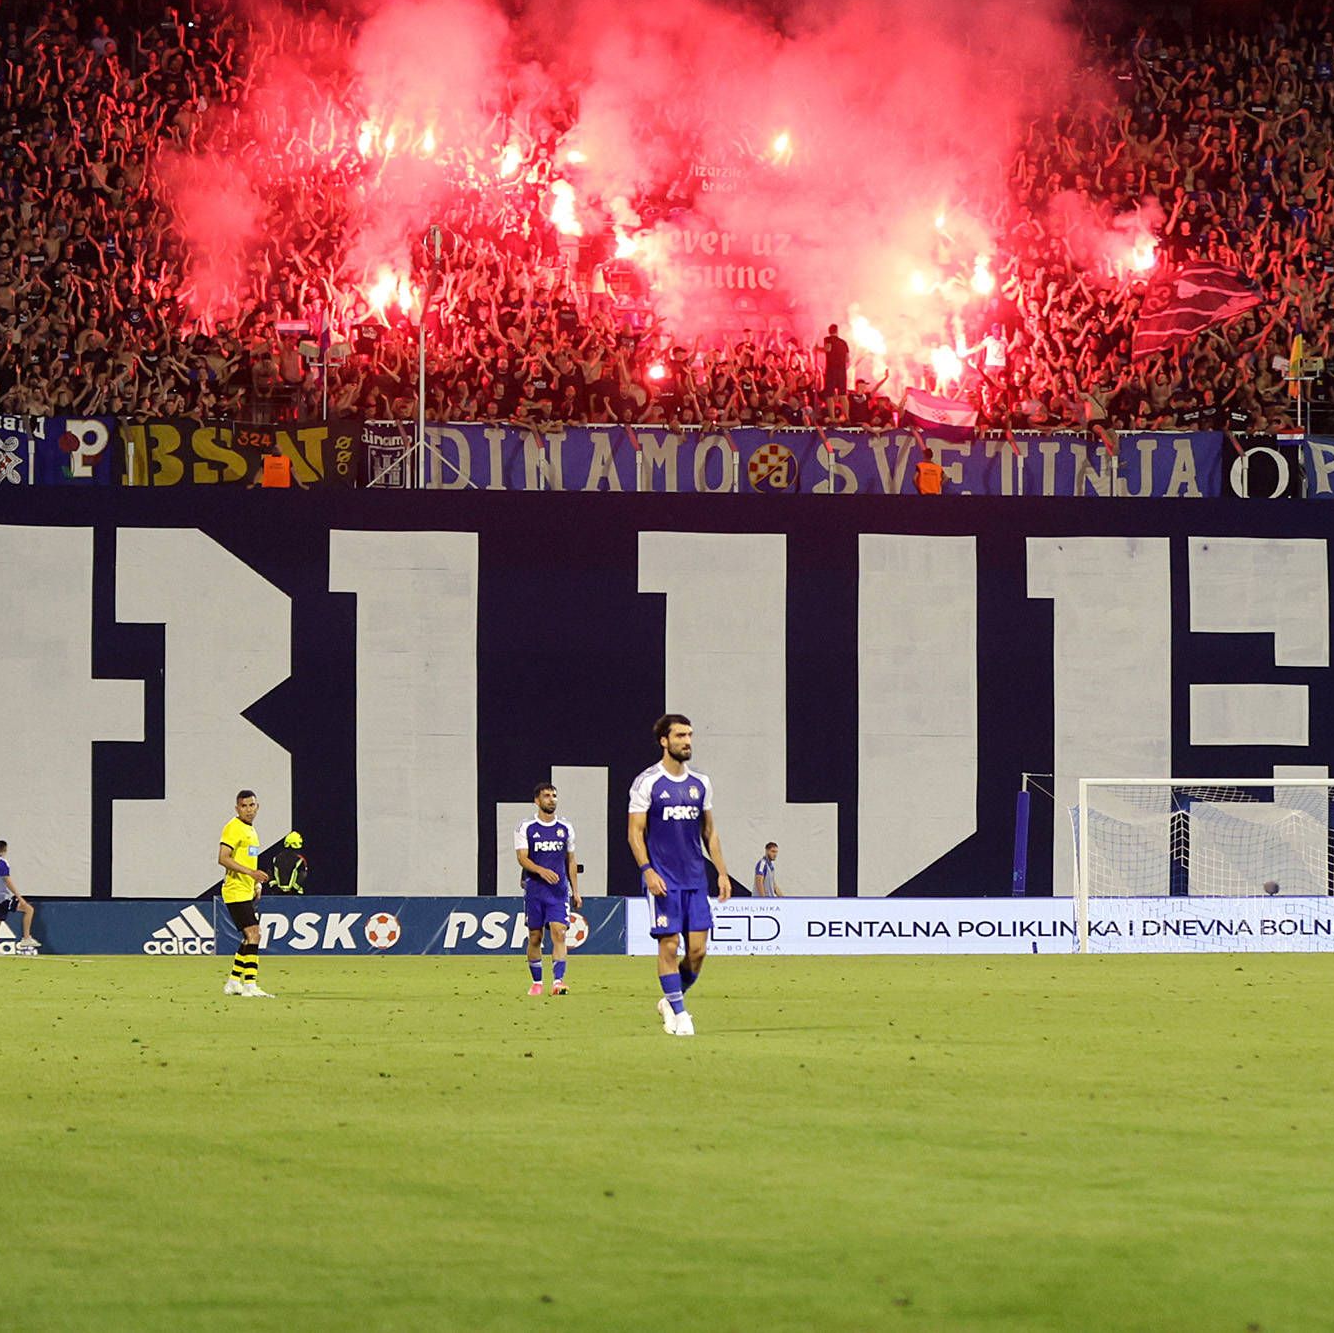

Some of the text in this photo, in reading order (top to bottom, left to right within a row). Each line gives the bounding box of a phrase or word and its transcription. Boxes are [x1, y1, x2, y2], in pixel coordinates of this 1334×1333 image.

[426, 427, 735, 493] DINAMO
[258, 913, 362, 950] PSK
[806, 920, 951, 938] DENTALNA
[958, 920, 1119, 938] POLIKLINKA
[1142, 919, 1253, 937] DNEVNA
